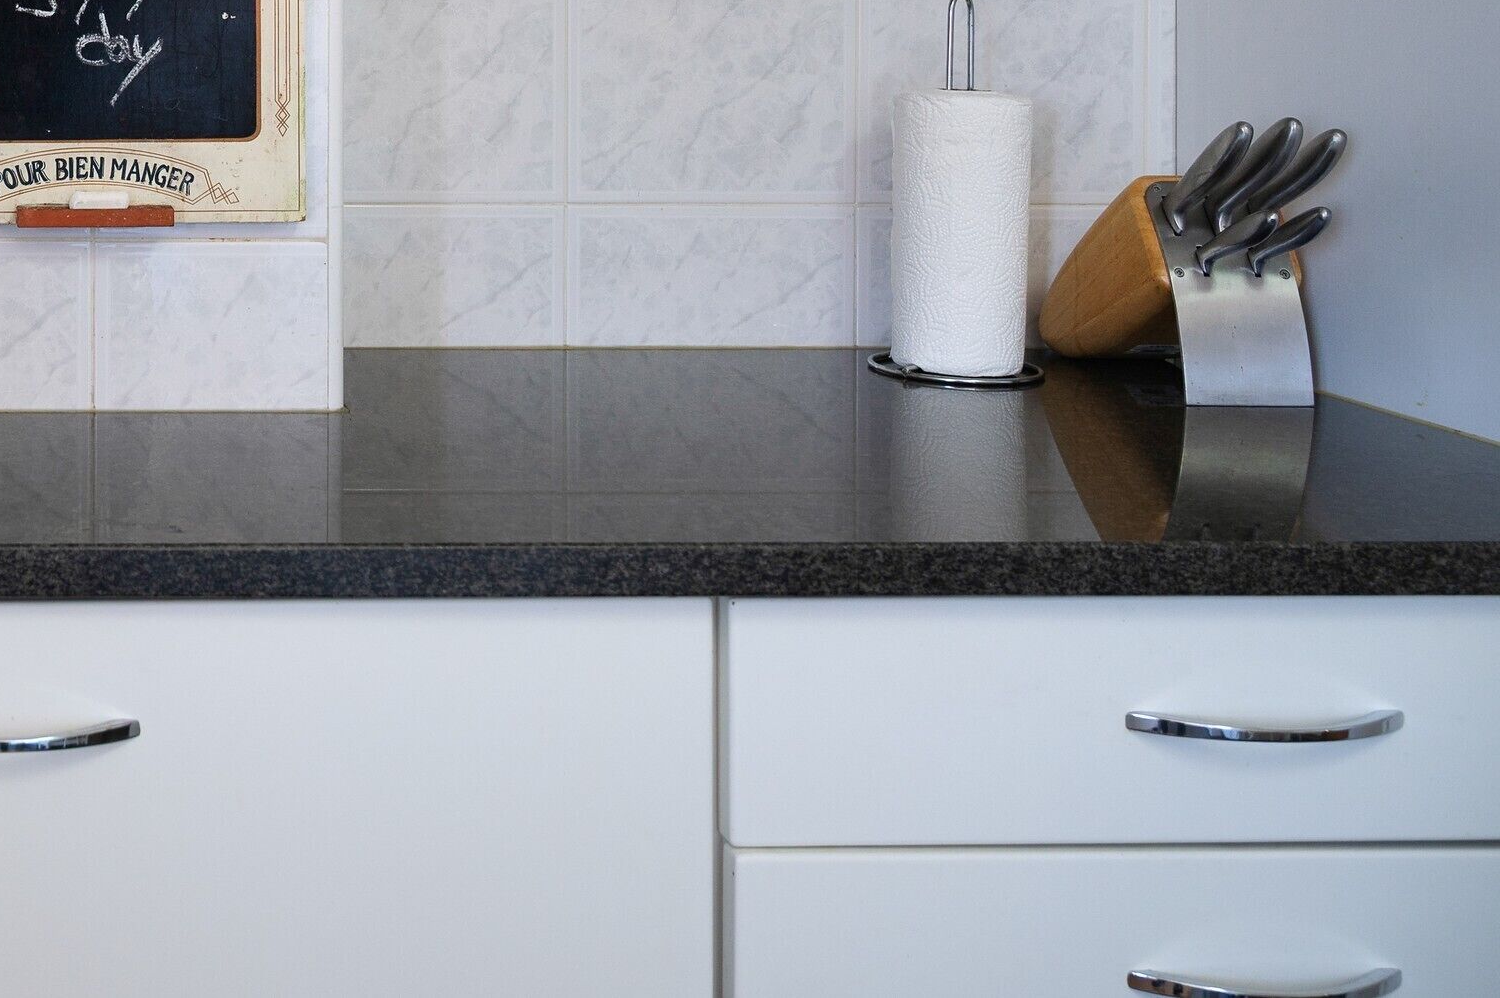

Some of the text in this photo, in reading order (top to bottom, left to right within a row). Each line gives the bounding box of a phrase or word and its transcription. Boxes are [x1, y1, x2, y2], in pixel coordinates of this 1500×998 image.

[75, 8, 163, 106] day
[55, 156, 105, 182] BIEN
[110, 157, 195, 196] MANGER
